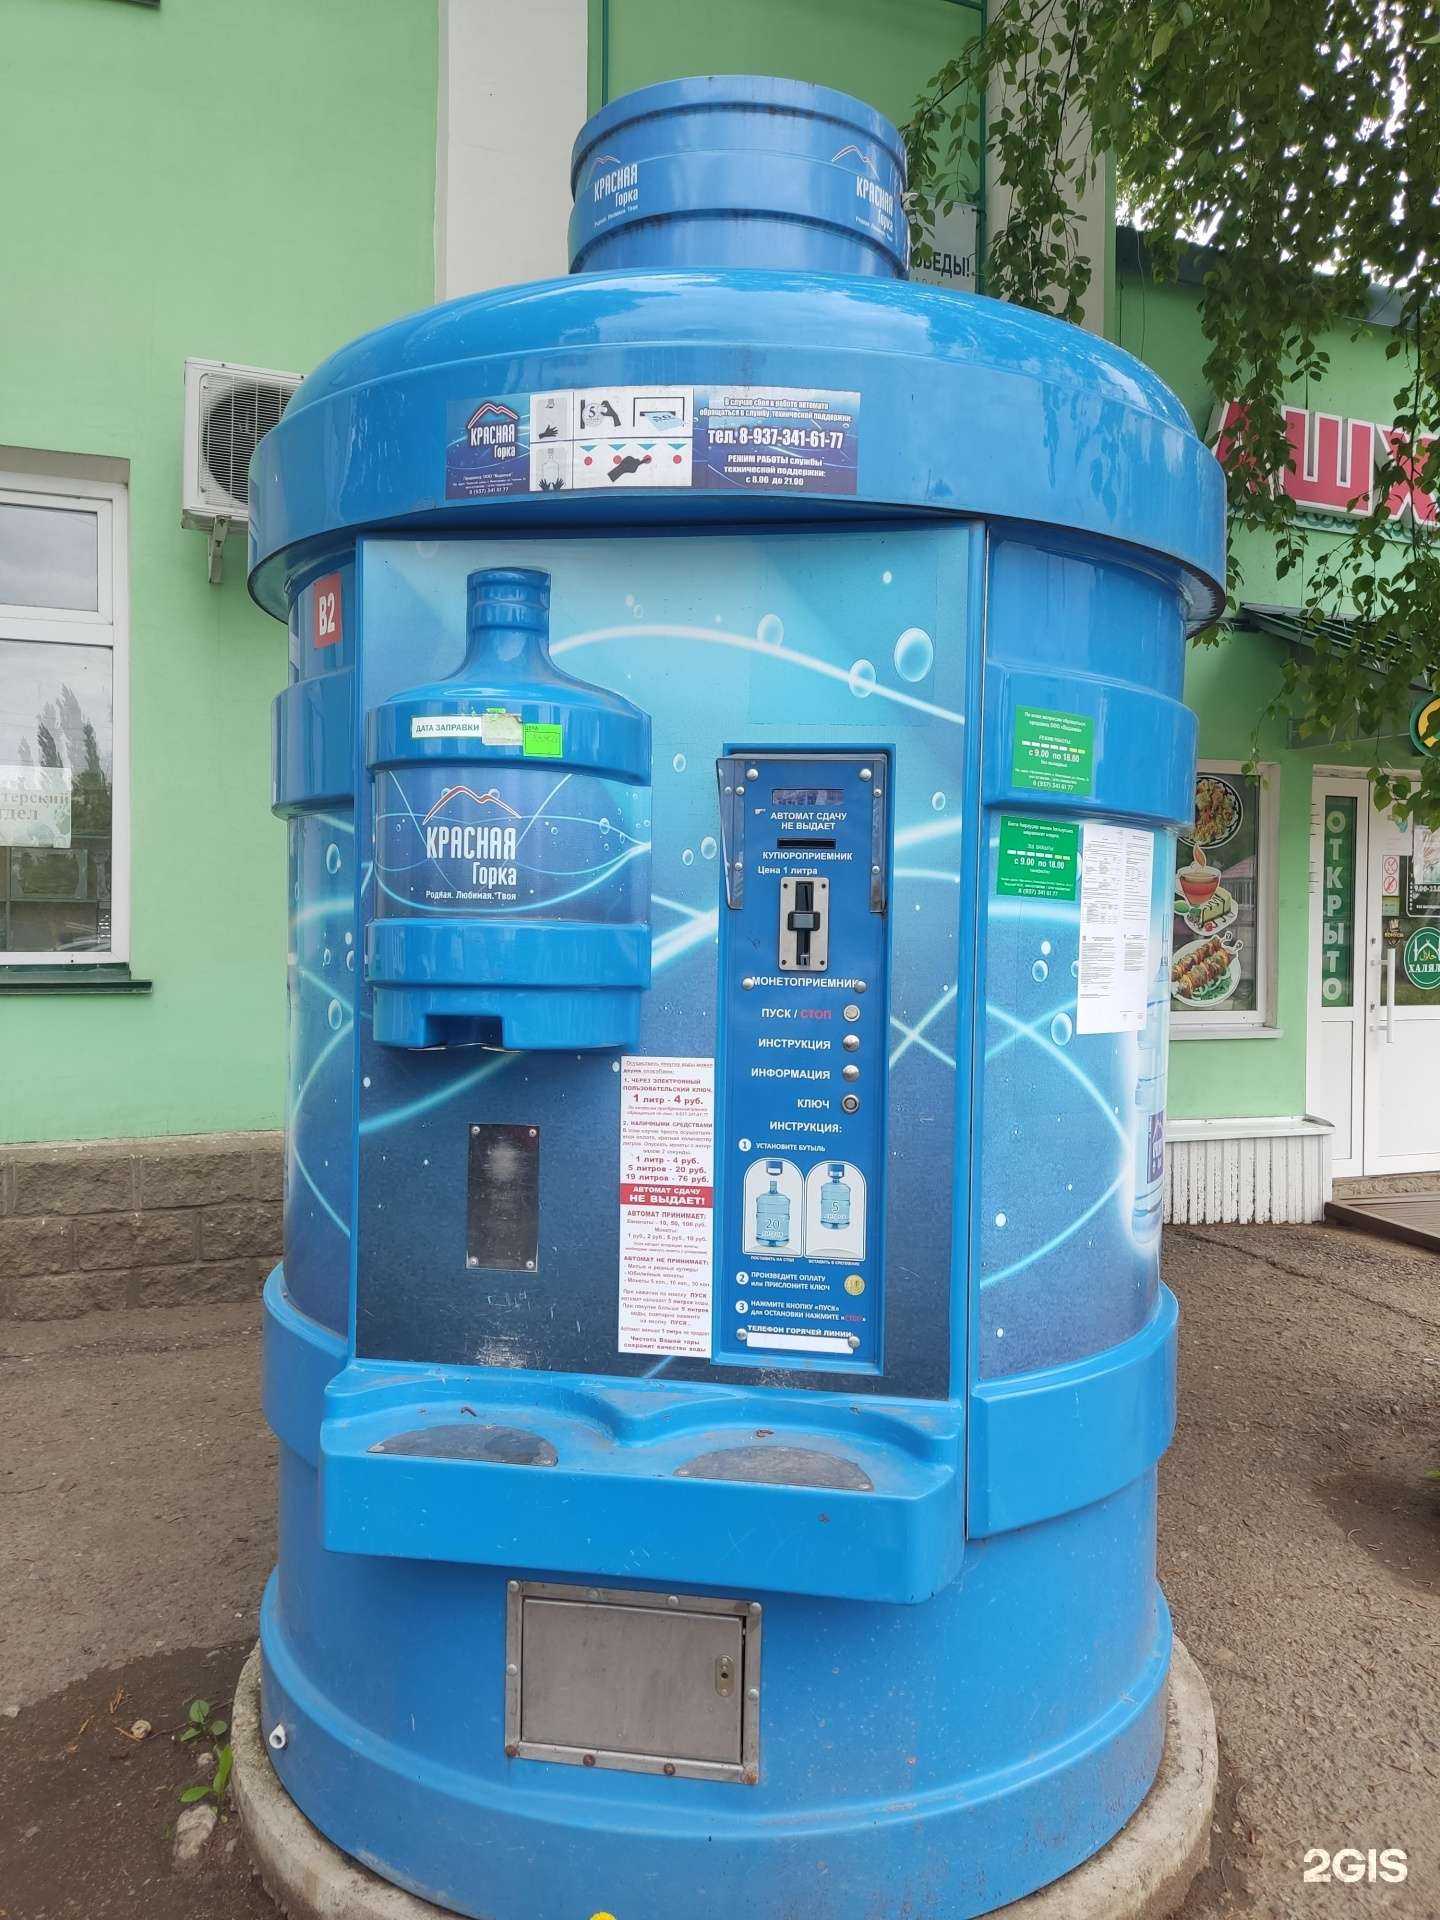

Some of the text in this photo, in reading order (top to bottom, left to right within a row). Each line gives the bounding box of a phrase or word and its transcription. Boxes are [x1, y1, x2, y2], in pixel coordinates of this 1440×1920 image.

[594, 163, 638, 203] КРАСНАЯ
[615, 188, 638, 207] Горка
[470, 424, 515, 446] КРАСНАЯ
[708, 427, 843, 449] тел. 8-937-341-61-77
[494, 445, 515, 460] Горка
[727, 454, 823, 467] РЕЖИМ РАБОТЫ службы
[724, 466, 776, 474] технической
[771, 477, 783, 485] до
[783, 477, 804, 486] 21.00
[416, 724, 480, 732] ДАТА ЗАПРАВКИ
[770, 812, 847, 822] АВТОМАТ СДАЧУ
[781, 822, 836, 831] НЕ ВЫДАЕТ
[426, 826, 516, 860] КРАСНАЯ
[762, 851, 853, 861] КУПЮРОПРИЕМНИК
[472, 861, 517, 889] Горка
[757, 866, 818, 876] Цена 1 литра
[1323, 811, 1346, 1000] ОТКРЫТО
[752, 976, 858, 988] МОНЕТОПРИЕМНИК
[761, 1008, 792, 1019] ПУСК
[799, 1009, 832, 1019] СТОП
[758, 1038, 831, 1050] ИНСТРУКЦИЯ
[751, 1068, 831, 1080] ИНФОРМАЦИЯ
[623, 1085, 690, 1093] ПОЛЬЗОВАТЕЛЬСКИЙ
[633, 1094, 639, 1102] 1
[643, 1096, 665, 1105] литр
[674, 1094, 681, 1104] 4
[684, 1097, 704, 1105] руб.
[797, 1099, 830, 1109] КЛЮЧ
[769, 1121, 842, 1134] ИНСТРУКЦИЯ:
[755, 1142, 798, 1151] УСТАНОВИТЕ
[798, 1144, 826, 1152] БУТЫЛЬ
[688, 1167, 707, 1175] руб.
[691, 1175, 709, 1184] руб.
[673, 1187, 701, 1195] СДАЧУ
[629, 1194, 705, 1206] НЕ ВЫДАЕТ!
[832, 1200, 839, 1212] 5
[627, 1210, 660, 1218] АВТОМАТ
[766, 1218, 780, 1230] 20
[751, 1271, 798, 1281] ПРОИЗВЕДИТЕ
[798, 1273, 826, 1282] ОПЛАТУ
[764, 1281, 808, 1290] ПРИСЛОНИТЕ
[809, 1283, 830, 1291] КЛЮЧ
[751, 1300, 784, 1309] НАЖМИТЕ
[785, 1302, 813, 1310] КНОПКУ
[763, 1309, 805, 1318] ОСТАНОВКИ
[805, 1312, 839, 1320] НАЖМИТЕ
[747, 1324, 784, 1333] ТЕЛЕФОН
[785, 1327, 822, 1336] ГОРЯЧЕЙ
